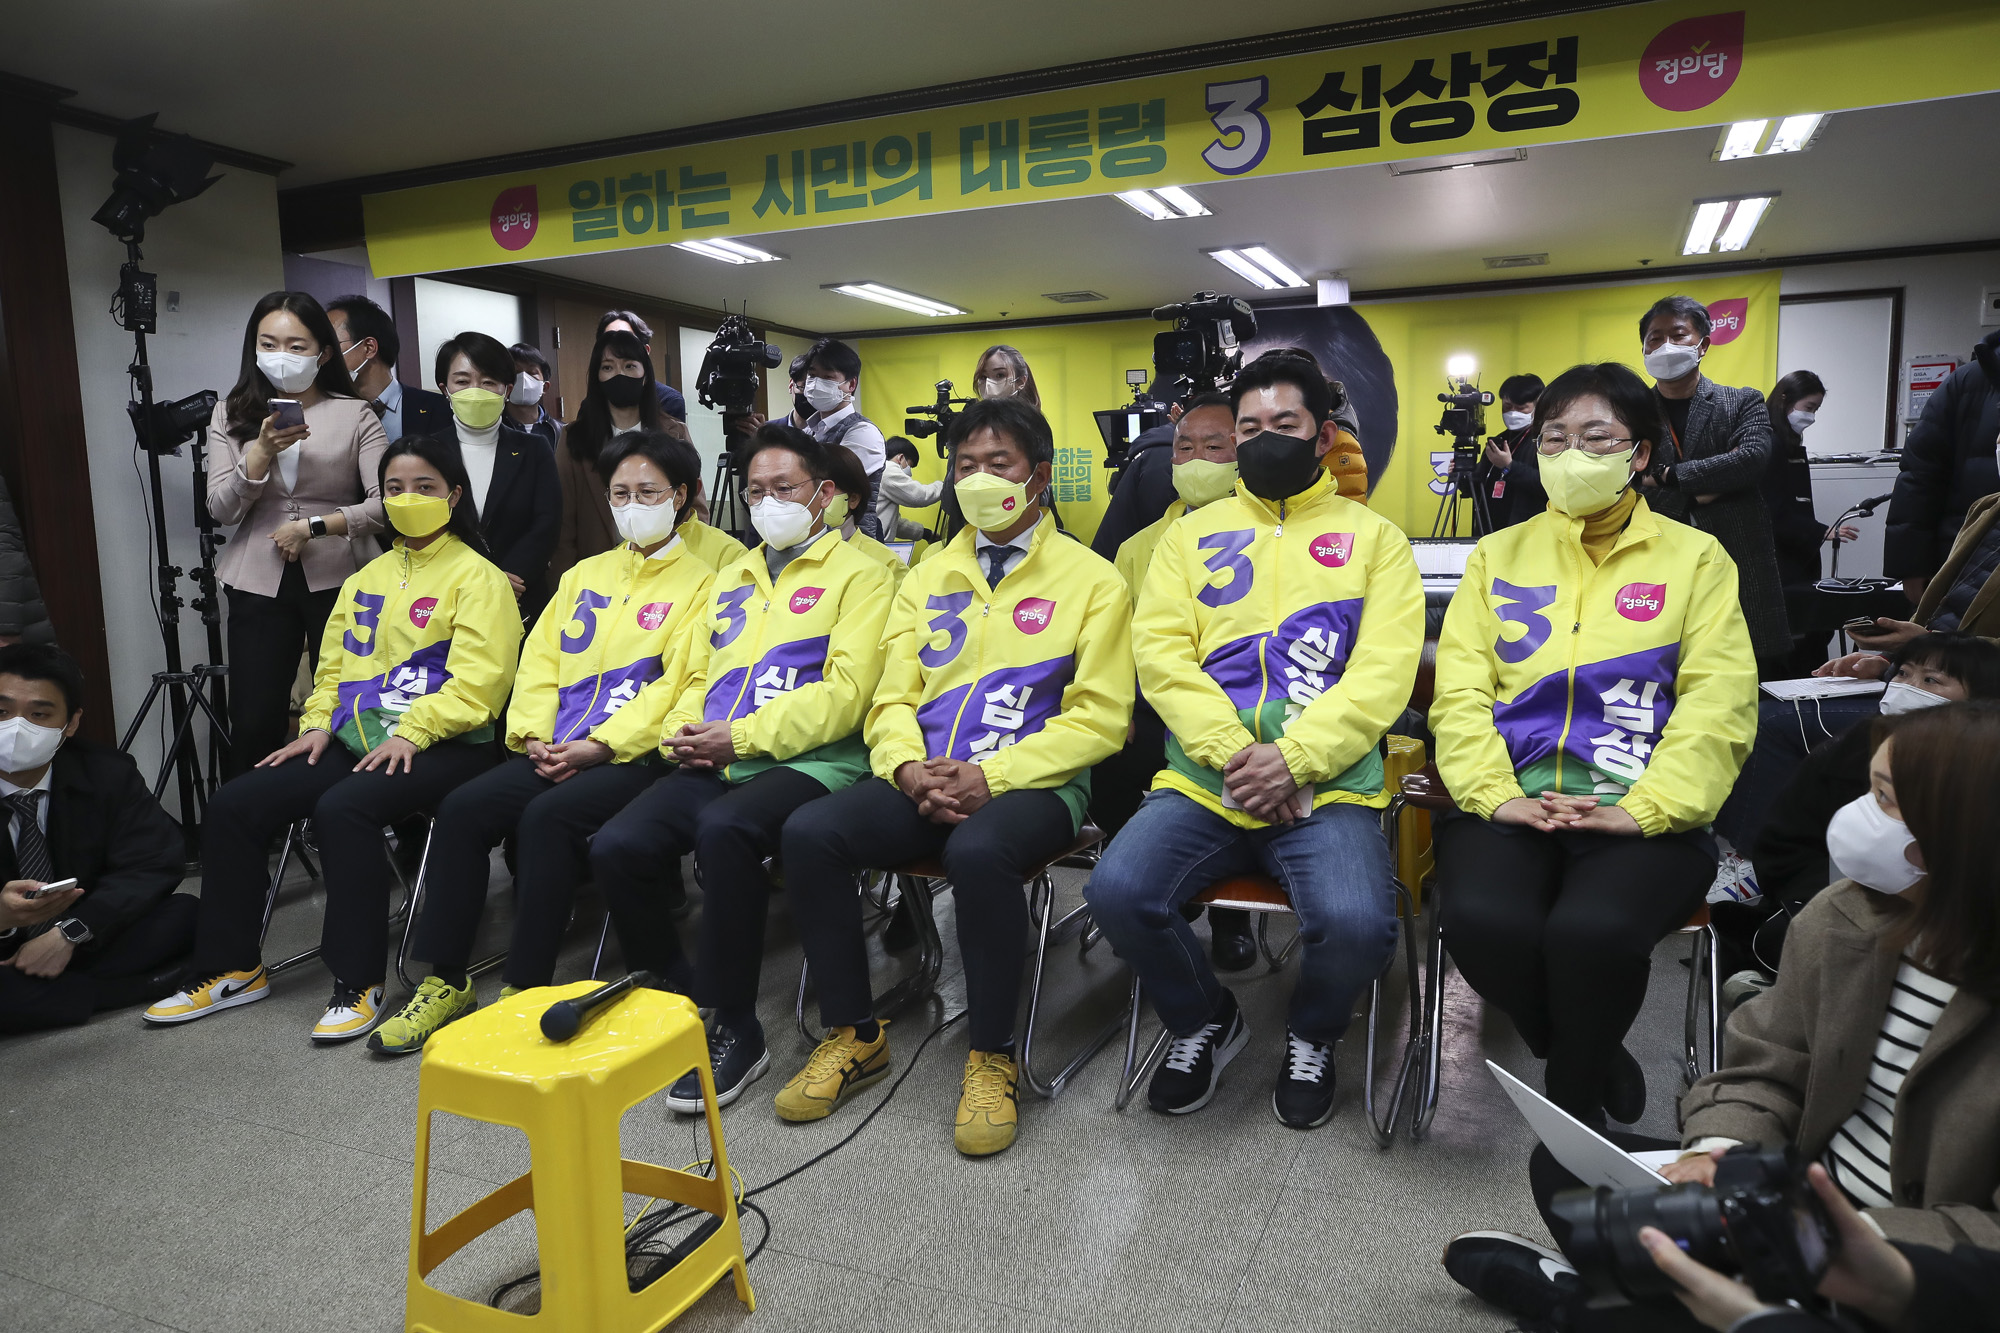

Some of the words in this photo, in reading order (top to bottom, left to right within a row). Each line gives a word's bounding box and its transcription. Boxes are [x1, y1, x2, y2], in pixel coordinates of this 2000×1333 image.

[1655, 53, 1728, 84] 정의당
[568, 166, 731, 243] 일하는
[752, 131, 932, 219] 시민의
[960, 98, 1168, 195] 대통령
[1201, 75, 1271, 175] 3
[1296, 36, 1580, 155] 심상정
[498, 212, 532, 232] 정의당
[1315, 545, 1346, 559] 정의당
[1197, 528, 1256, 608] 3
[795, 596, 817, 606] 정의당
[1622, 597, 1660, 611] 정의당
[343, 589, 386, 657] 3
[643, 611, 665, 623] 정의당
[709, 584, 756, 651] 3
[918, 590, 974, 668] 3
[1019, 610, 1047, 625] 정의당
[1490, 577, 1557, 663] 3
